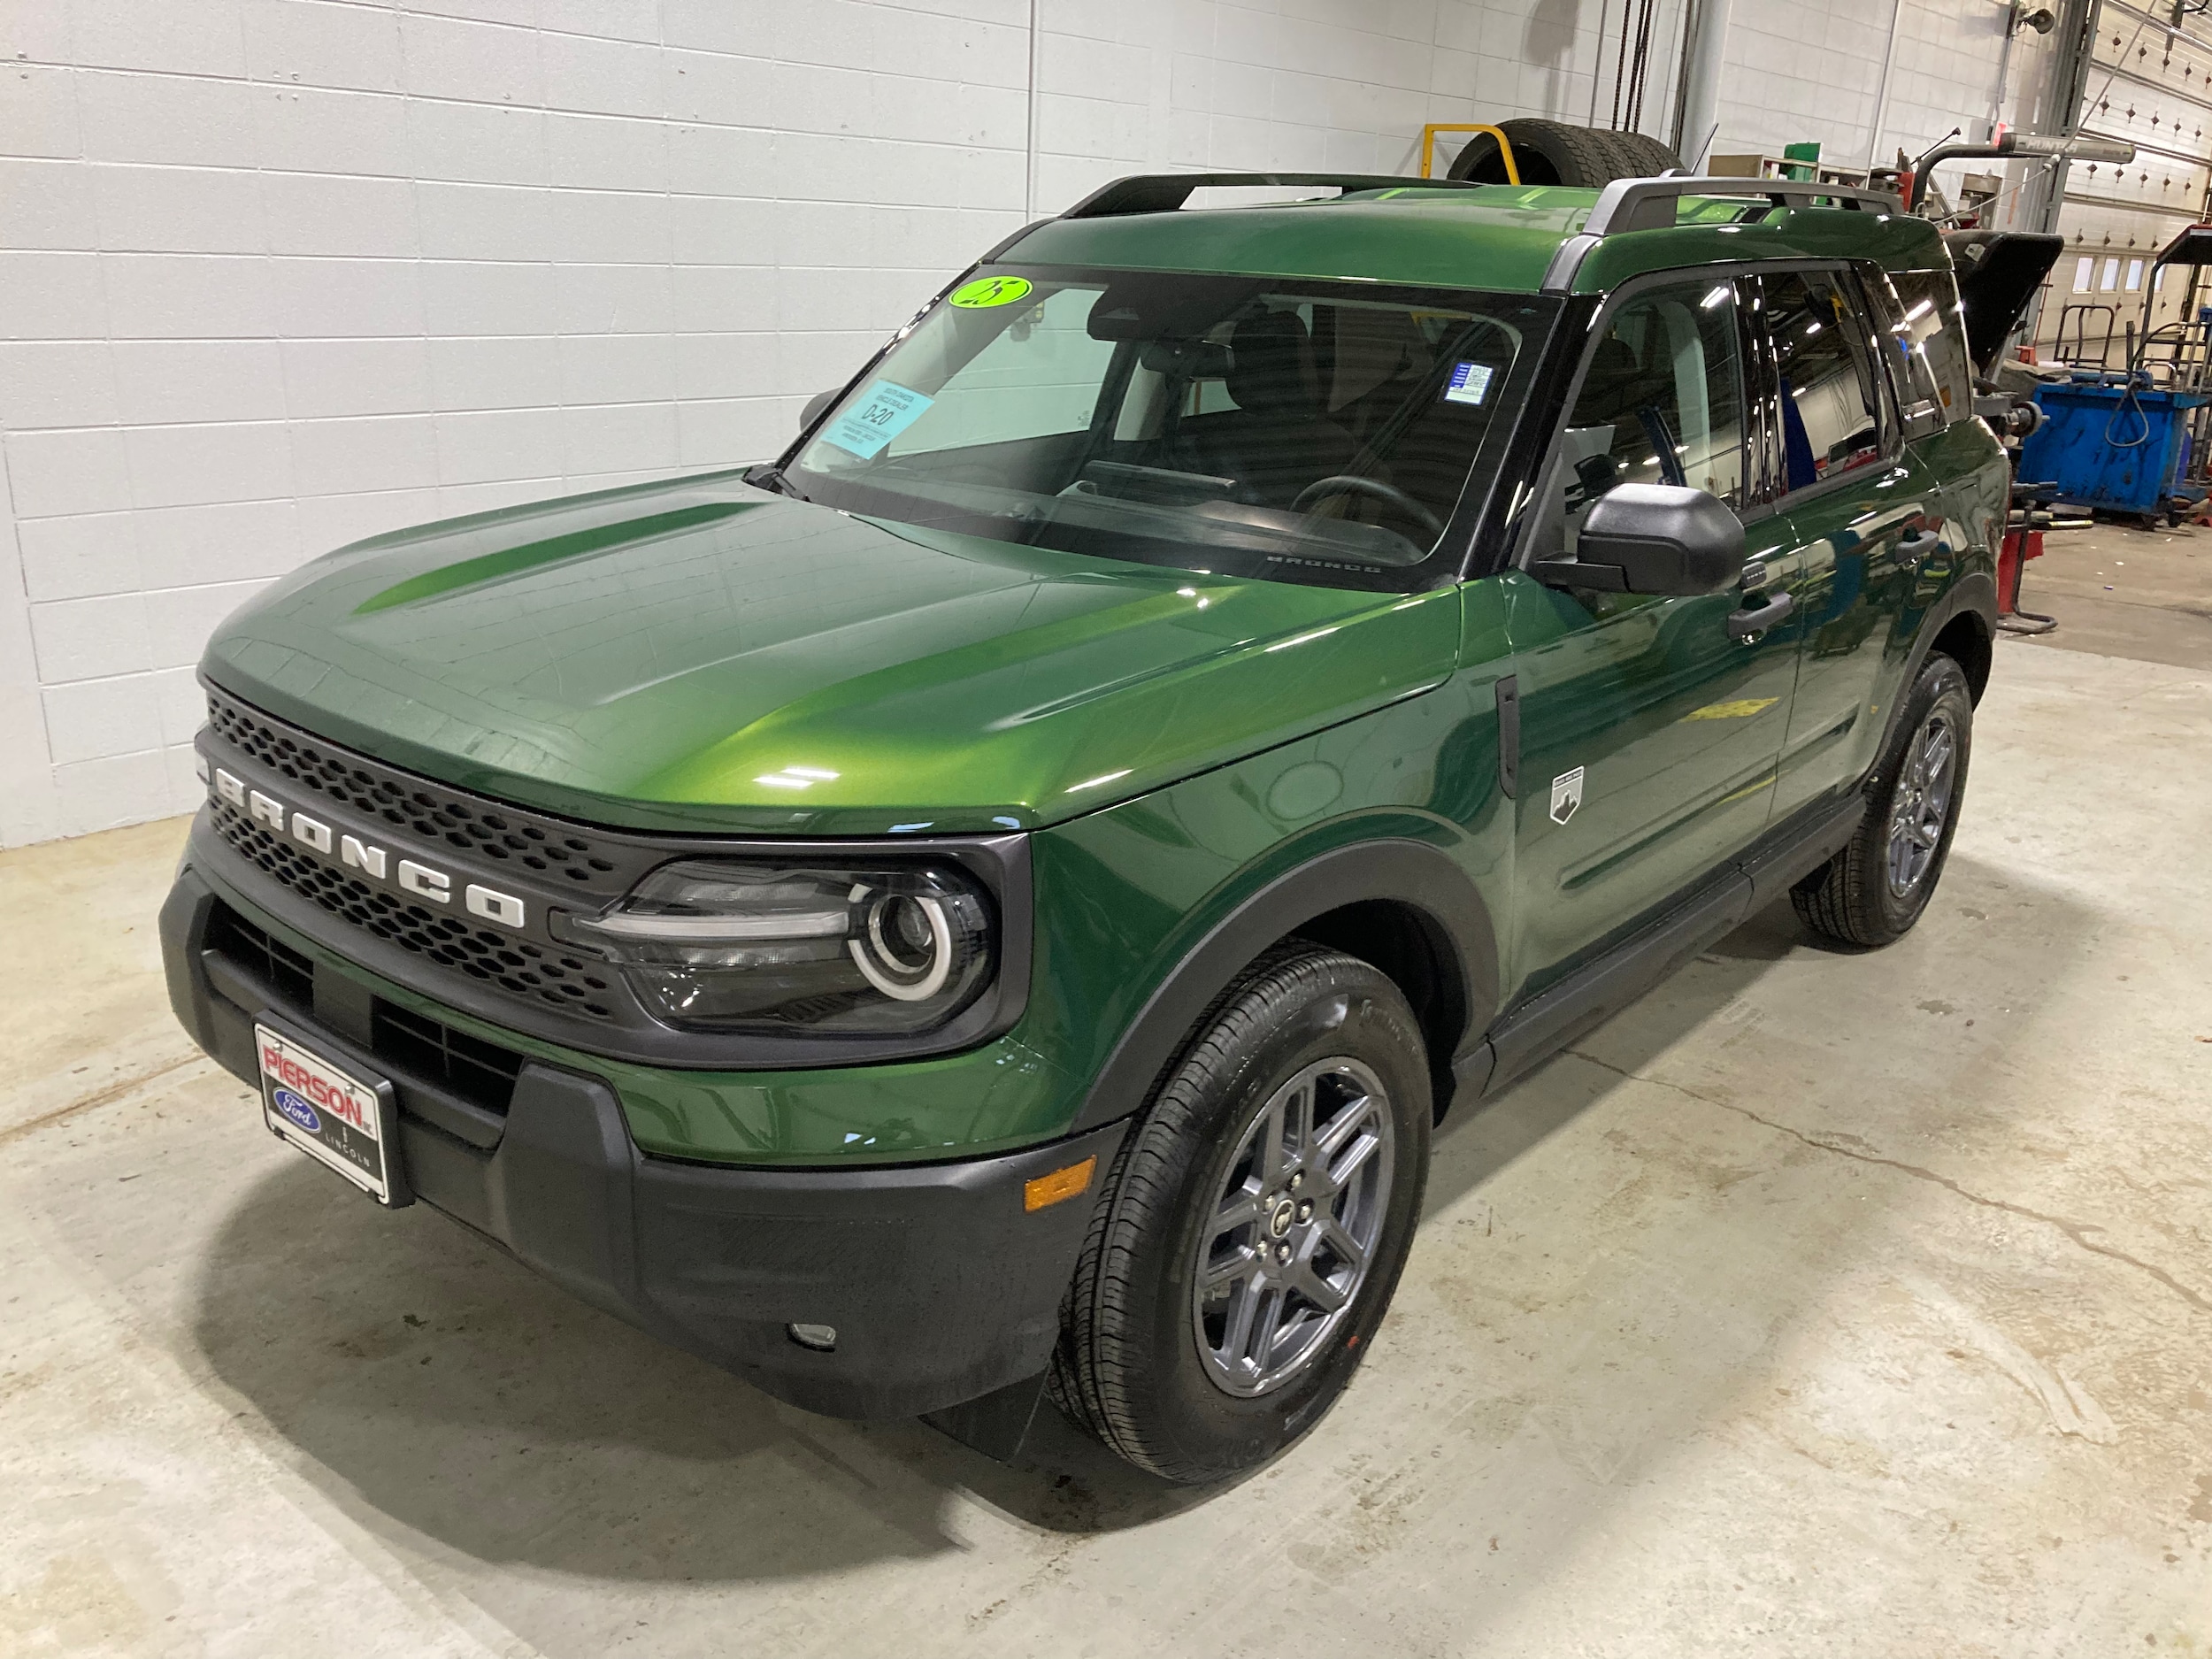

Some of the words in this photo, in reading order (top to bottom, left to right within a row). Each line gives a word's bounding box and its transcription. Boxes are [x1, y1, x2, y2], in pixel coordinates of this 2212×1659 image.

[861, 403, 895, 426] D-20
[1266, 556, 1381, 573] BRONCO
[216, 767, 525, 929] BRONCO
[263, 1044, 364, 1127] PIERSON
[282, 1094, 311, 1126] Ford
[325, 1132, 371, 1168] LINCOLN
